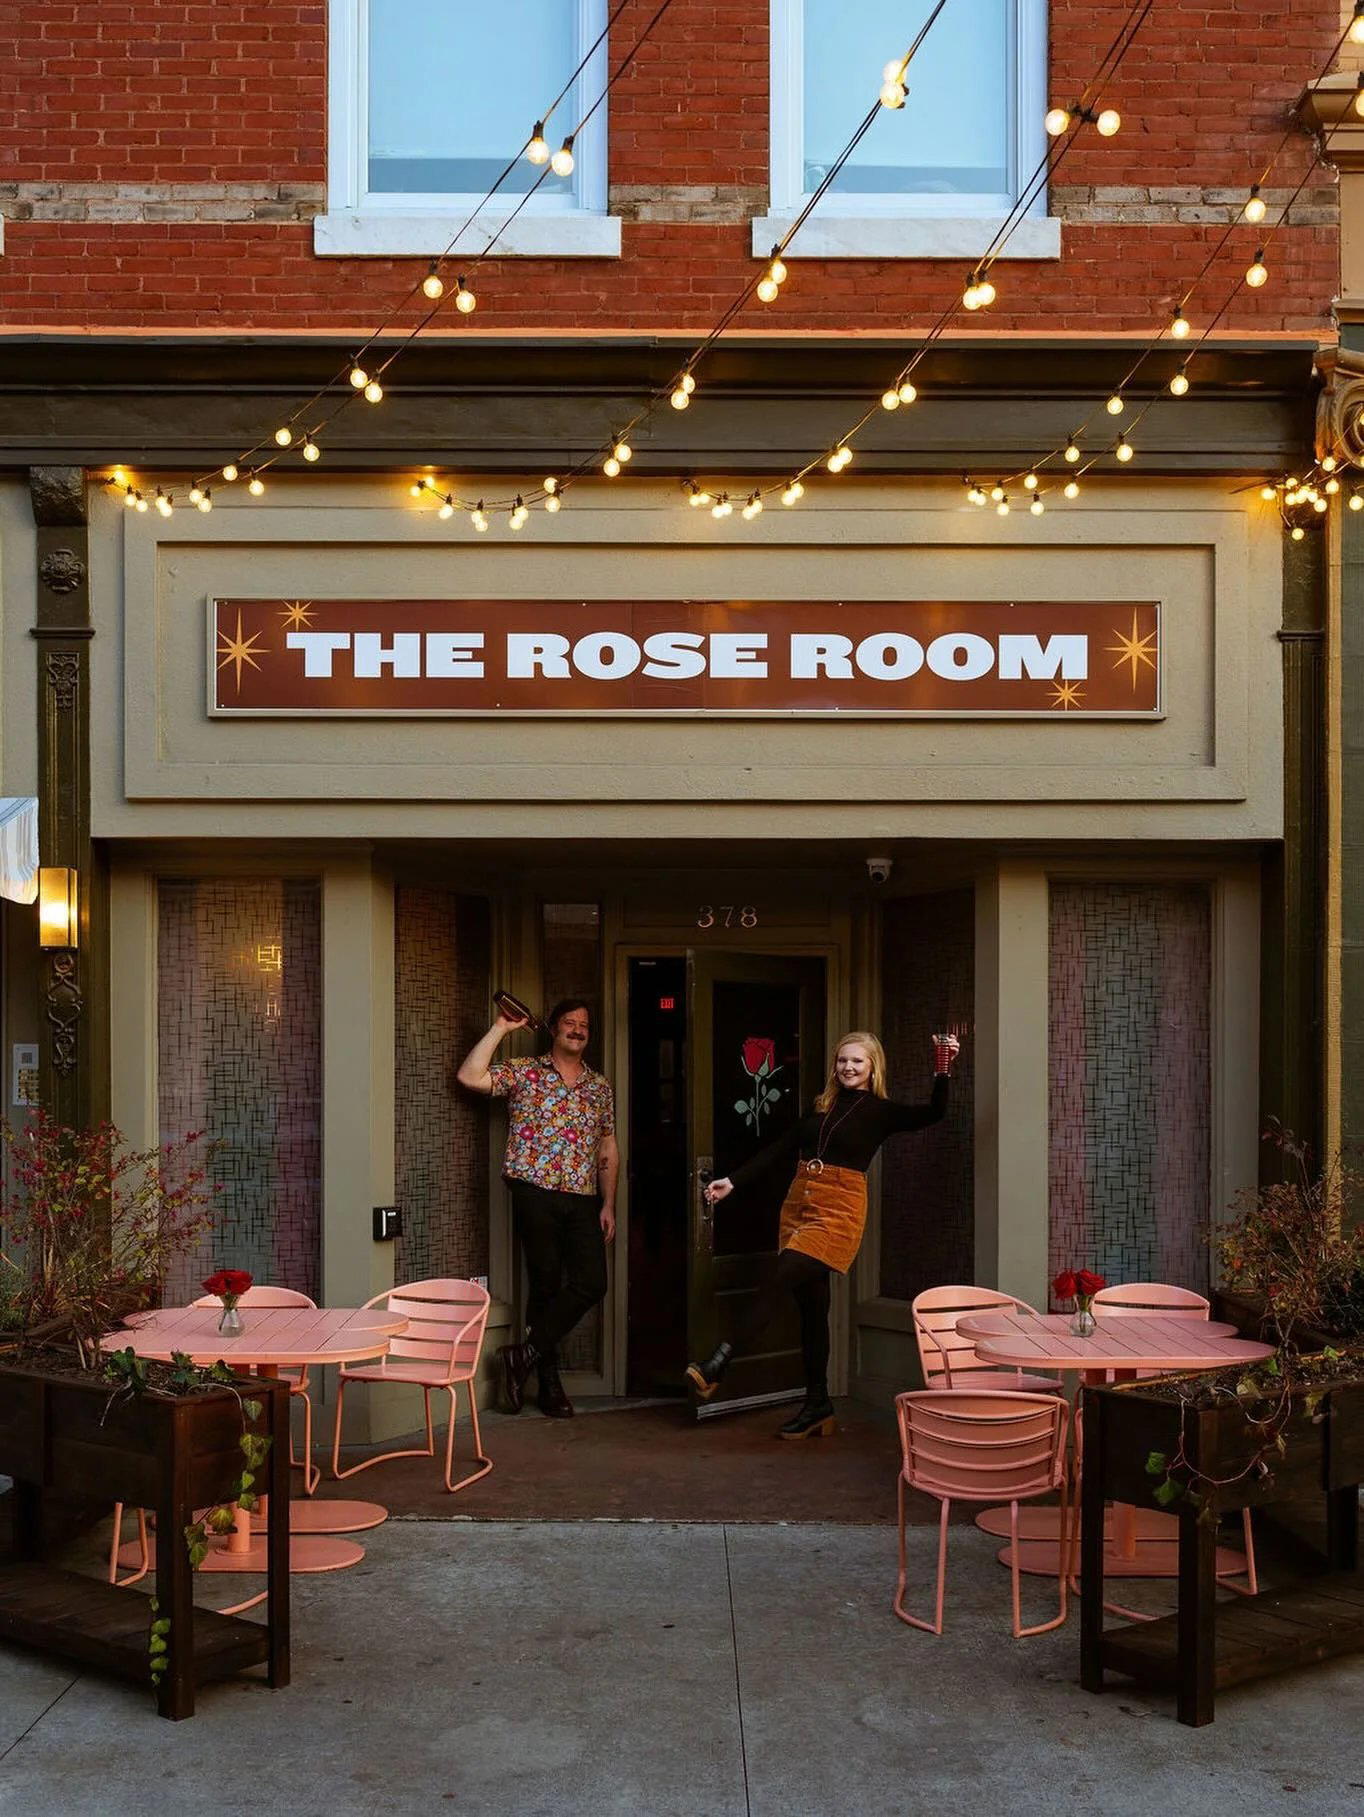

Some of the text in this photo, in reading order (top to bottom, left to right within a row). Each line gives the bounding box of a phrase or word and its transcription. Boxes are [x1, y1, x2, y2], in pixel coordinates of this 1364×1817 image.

[286, 631, 1088, 680] THE ROSE ROOM
[697, 905, 758, 928] 378
